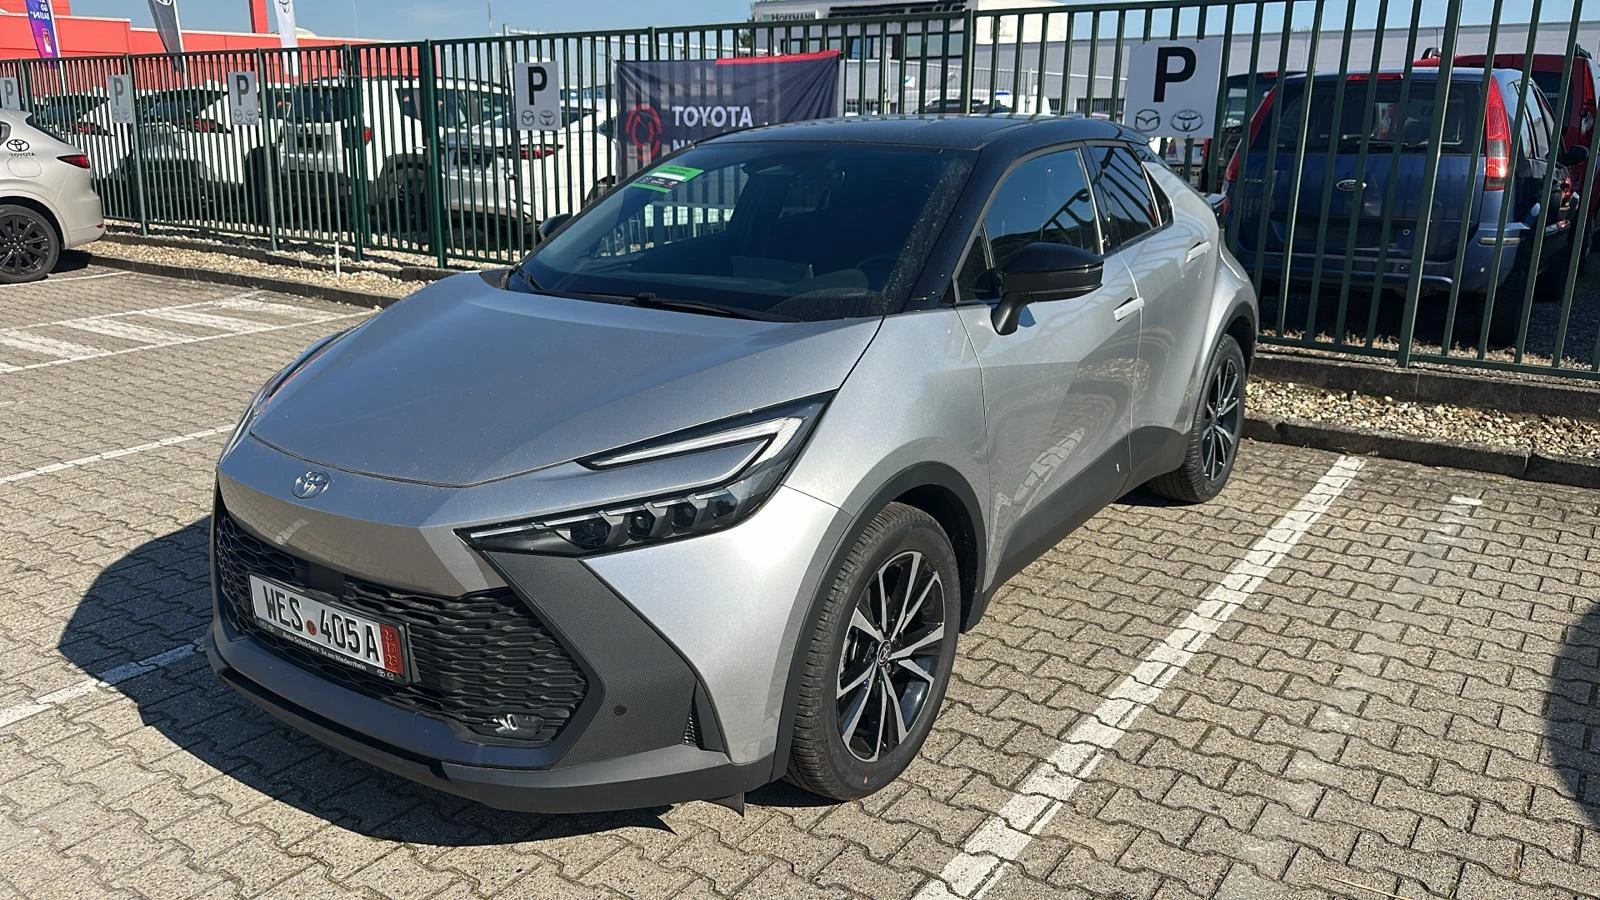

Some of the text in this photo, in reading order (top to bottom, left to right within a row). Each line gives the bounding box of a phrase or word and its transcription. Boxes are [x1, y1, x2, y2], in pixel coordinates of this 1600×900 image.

[236, 74, 250, 106] P
[527, 66, 548, 106] P
[1153, 46, 1197, 103] P
[4, 79, 14, 105] P
[113, 77, 125, 106] P
[671, 105, 754, 128] TOYOTA
[263, 585, 305, 632] WES
